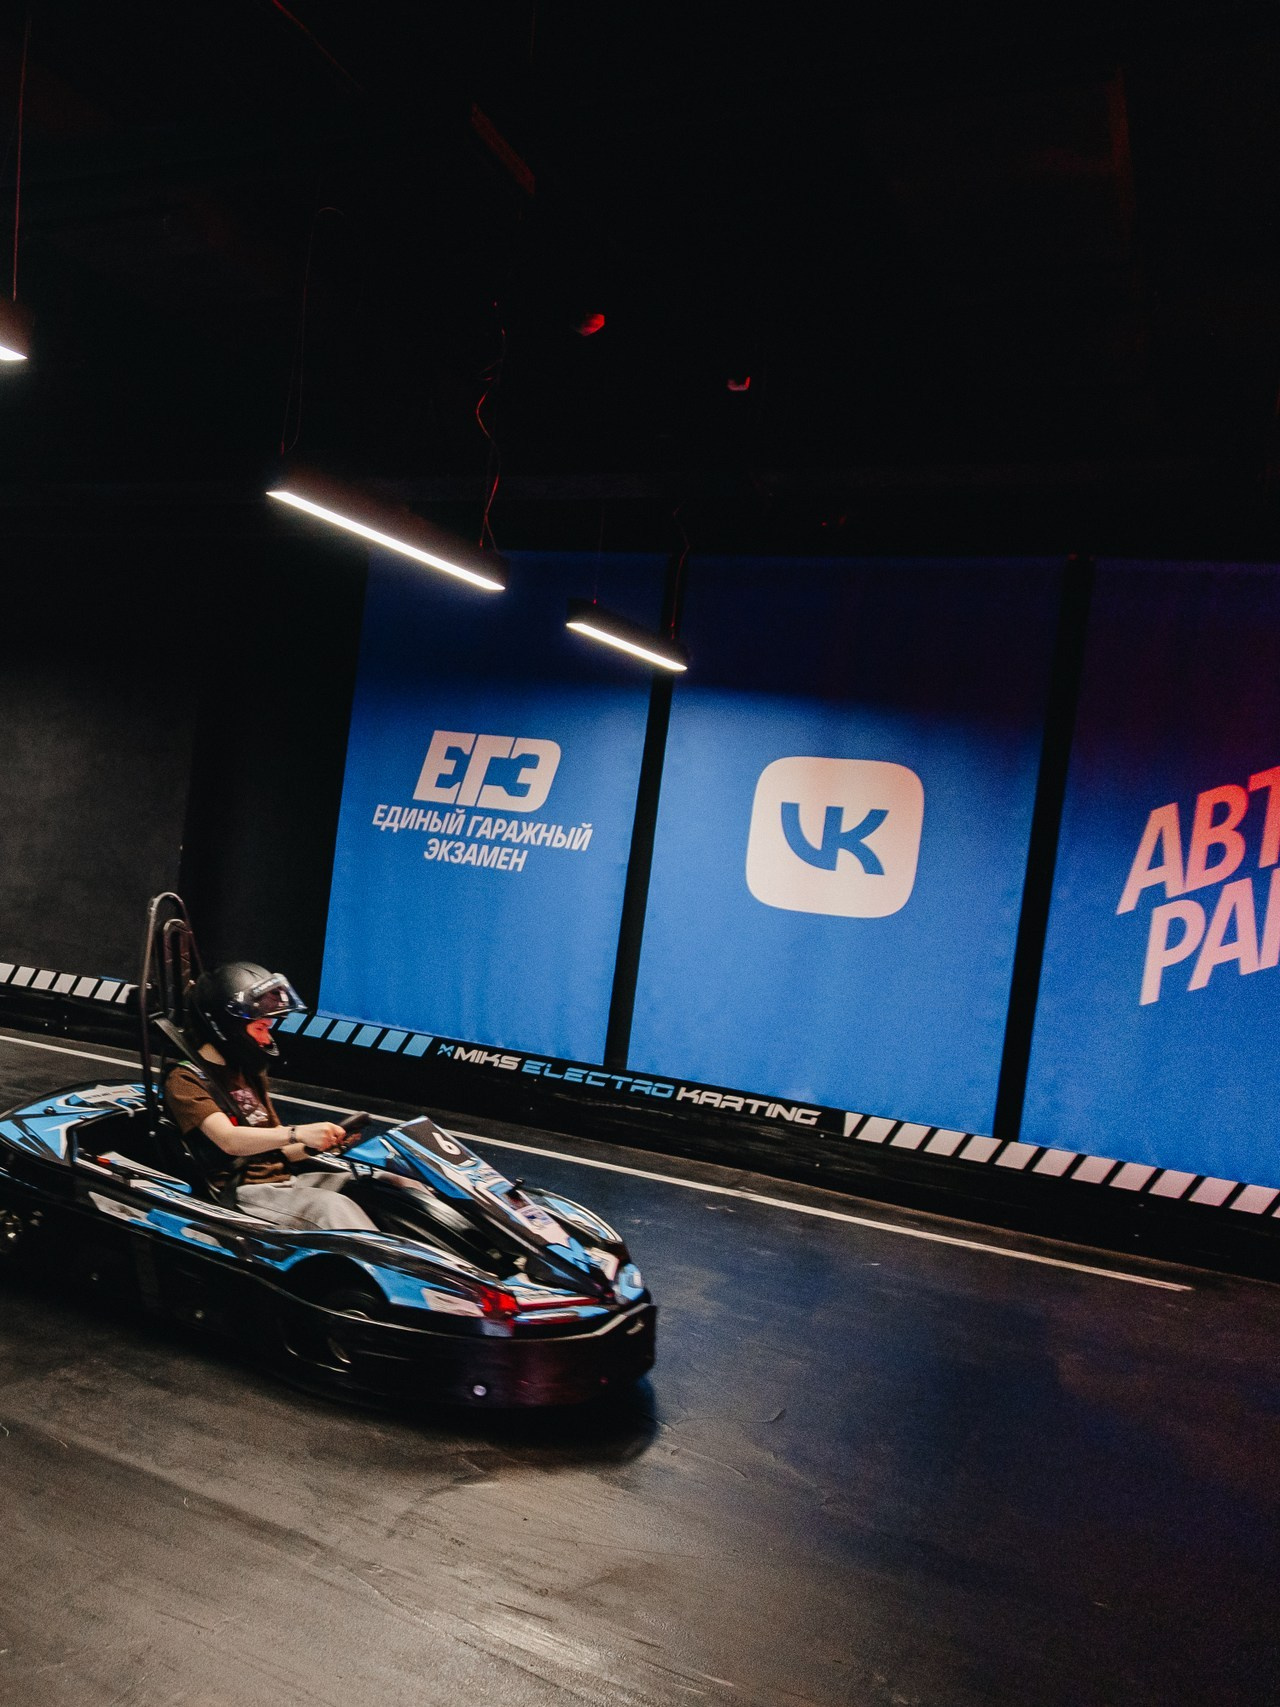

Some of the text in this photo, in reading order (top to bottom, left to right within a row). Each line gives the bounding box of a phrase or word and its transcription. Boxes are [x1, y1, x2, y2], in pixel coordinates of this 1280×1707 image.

[413, 730, 561, 813] ЕГЭ
[372, 804, 593, 851] ЕДИНЫЙ ГАРАЖНЫЙ
[423, 838, 528, 872] ЭКЗАМЕН
[453, 1046, 822, 1126] MIKS ELECTRO KARTING
[432, 1132, 461, 1155] 6
